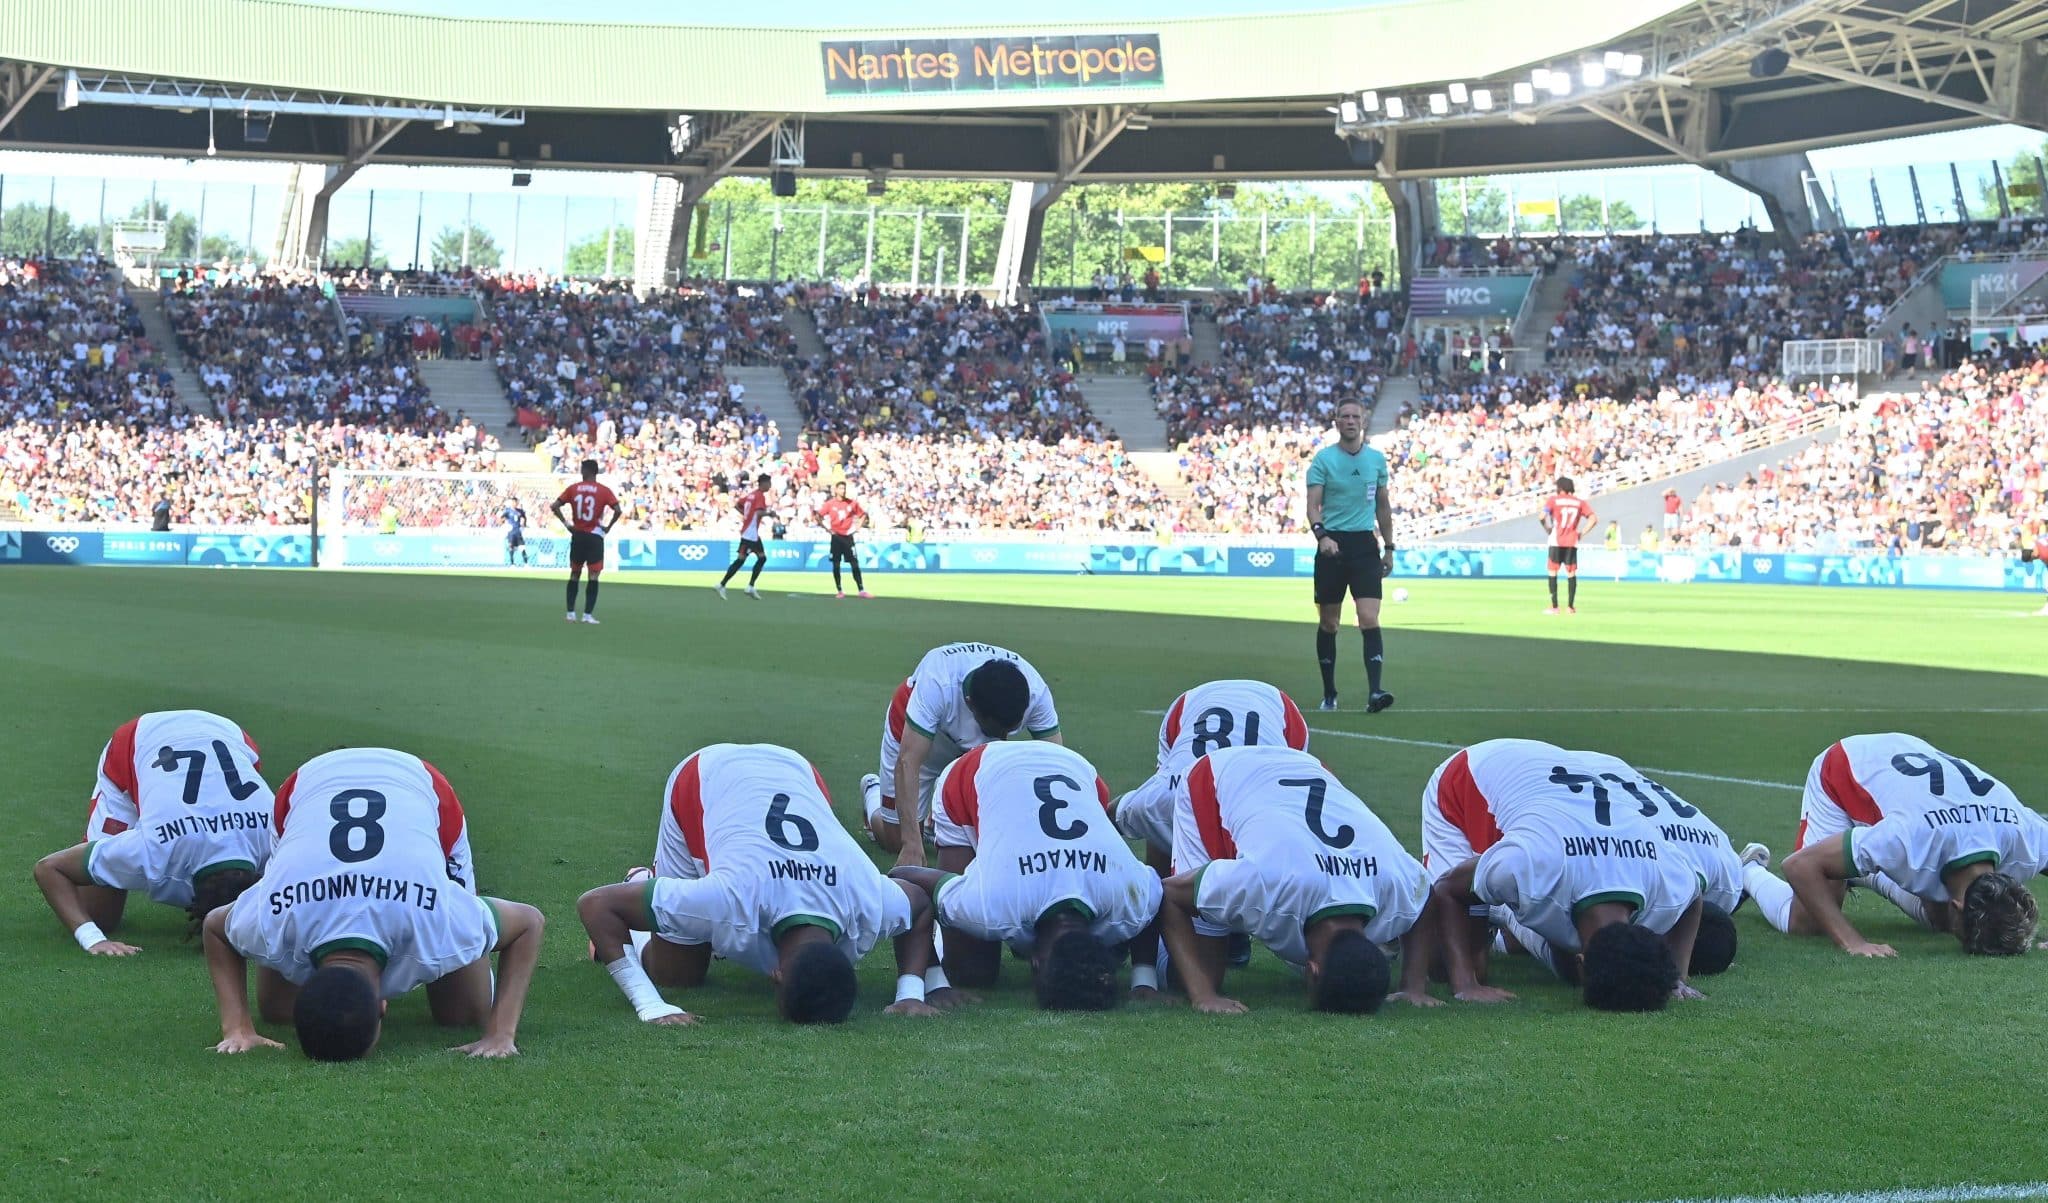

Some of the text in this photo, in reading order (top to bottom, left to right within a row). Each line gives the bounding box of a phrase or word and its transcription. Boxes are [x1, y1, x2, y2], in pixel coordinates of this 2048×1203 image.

[827, 47, 960, 80] Nantes
[573, 493, 596, 522] 13
[1560, 507, 1578, 528] 17
[149, 541, 181, 552] 2024
[1192, 707, 1260, 758] 18
[152, 739, 261, 804] 14
[1891, 750, 1995, 797] 16
[765, 792, 819, 852] 9
[1033, 774, 1089, 840] 3
[1278, 778, 1355, 849] 2
[329, 788, 387, 863] 8
[1657, 823, 1719, 848] AKHOM
[1019, 849, 1107, 876] NAKACH
[1563, 836, 1657, 861] BOUKAMIR
[768, 860, 837, 887] RAHIMI
[1315, 853, 1378, 879] HAKIMI
[270, 874, 437, 916] EL KHANNOUSS
